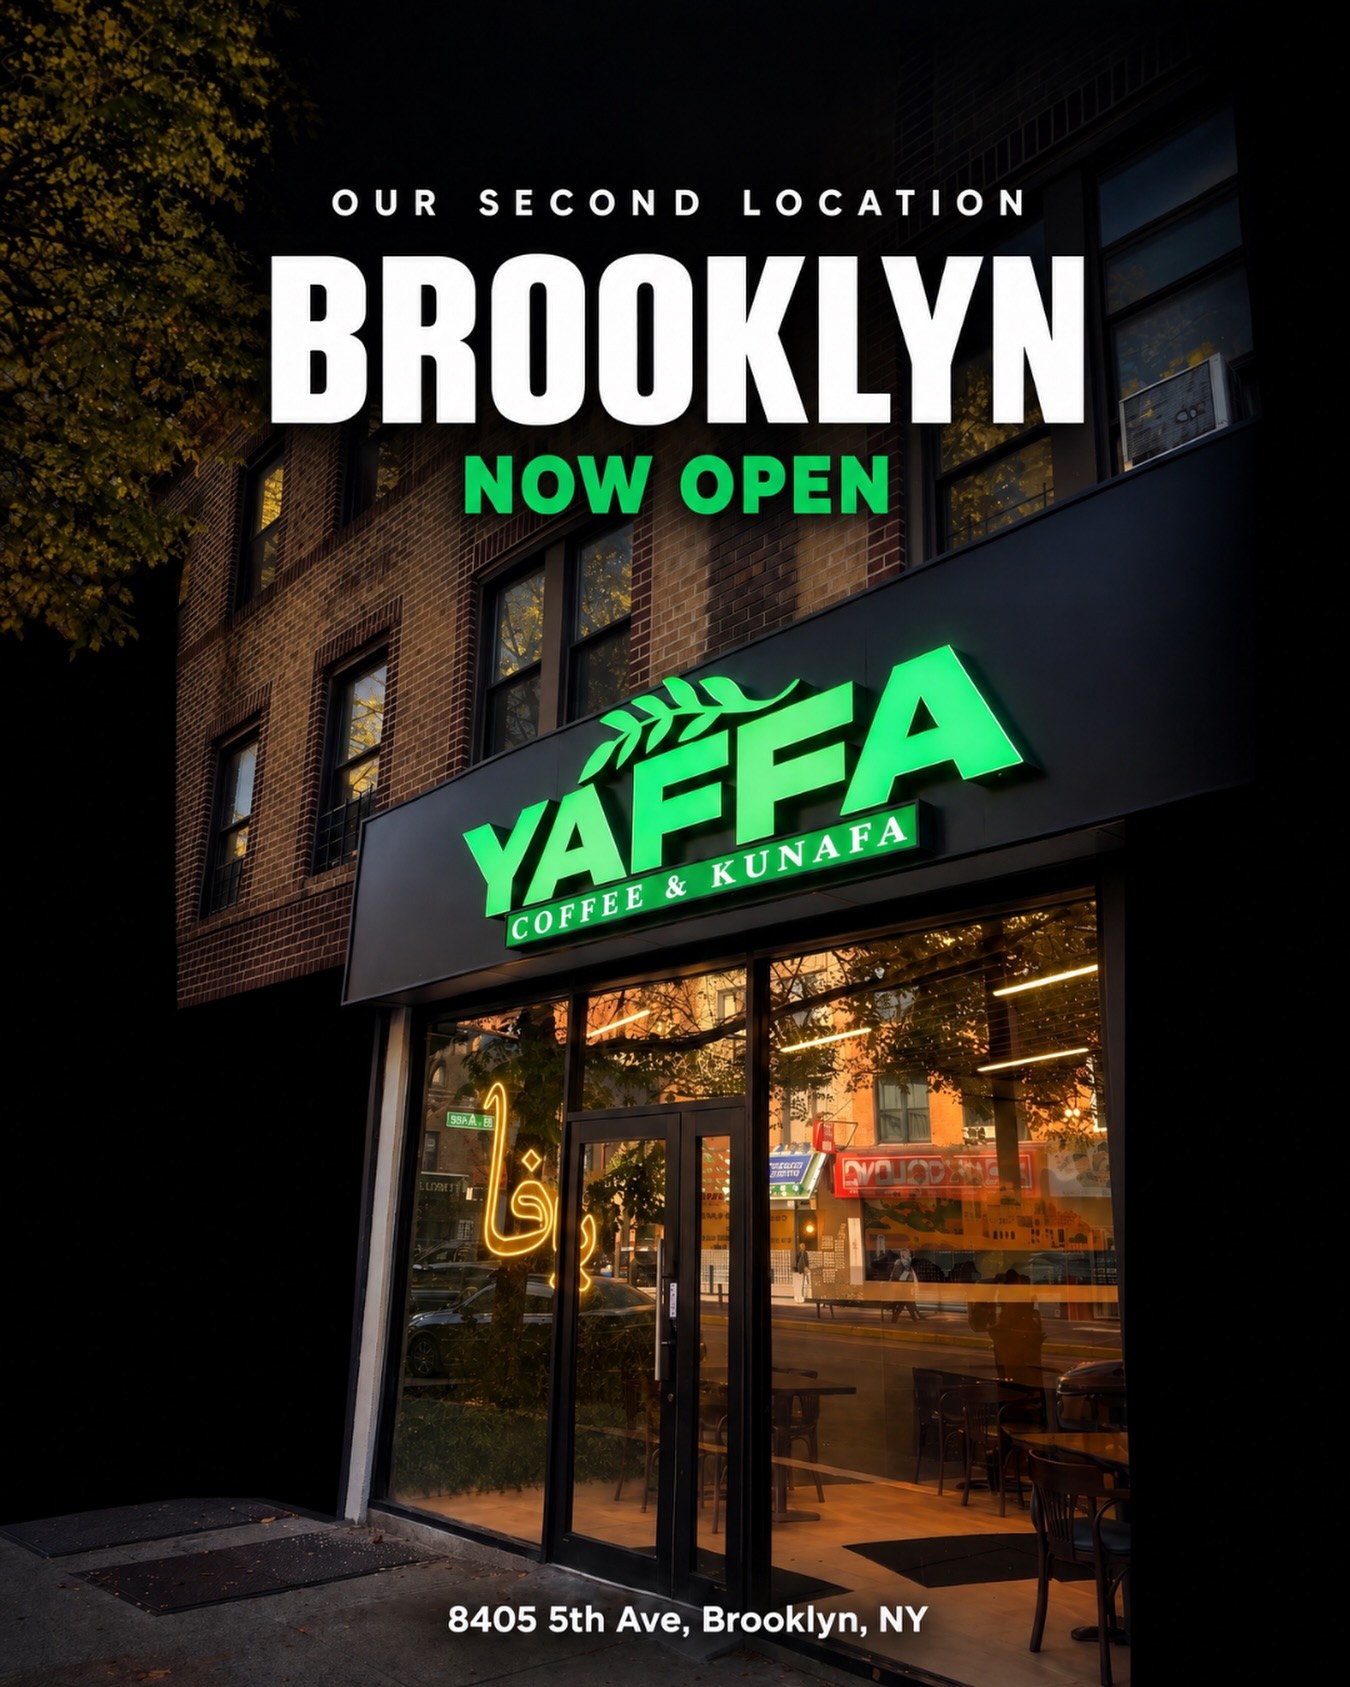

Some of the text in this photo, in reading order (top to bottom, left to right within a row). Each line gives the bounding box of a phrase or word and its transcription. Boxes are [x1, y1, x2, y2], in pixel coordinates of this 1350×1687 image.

[462, 644, 1023, 918] YAFFA
[511, 815, 908, 940] COFFEE & KUNAFA
